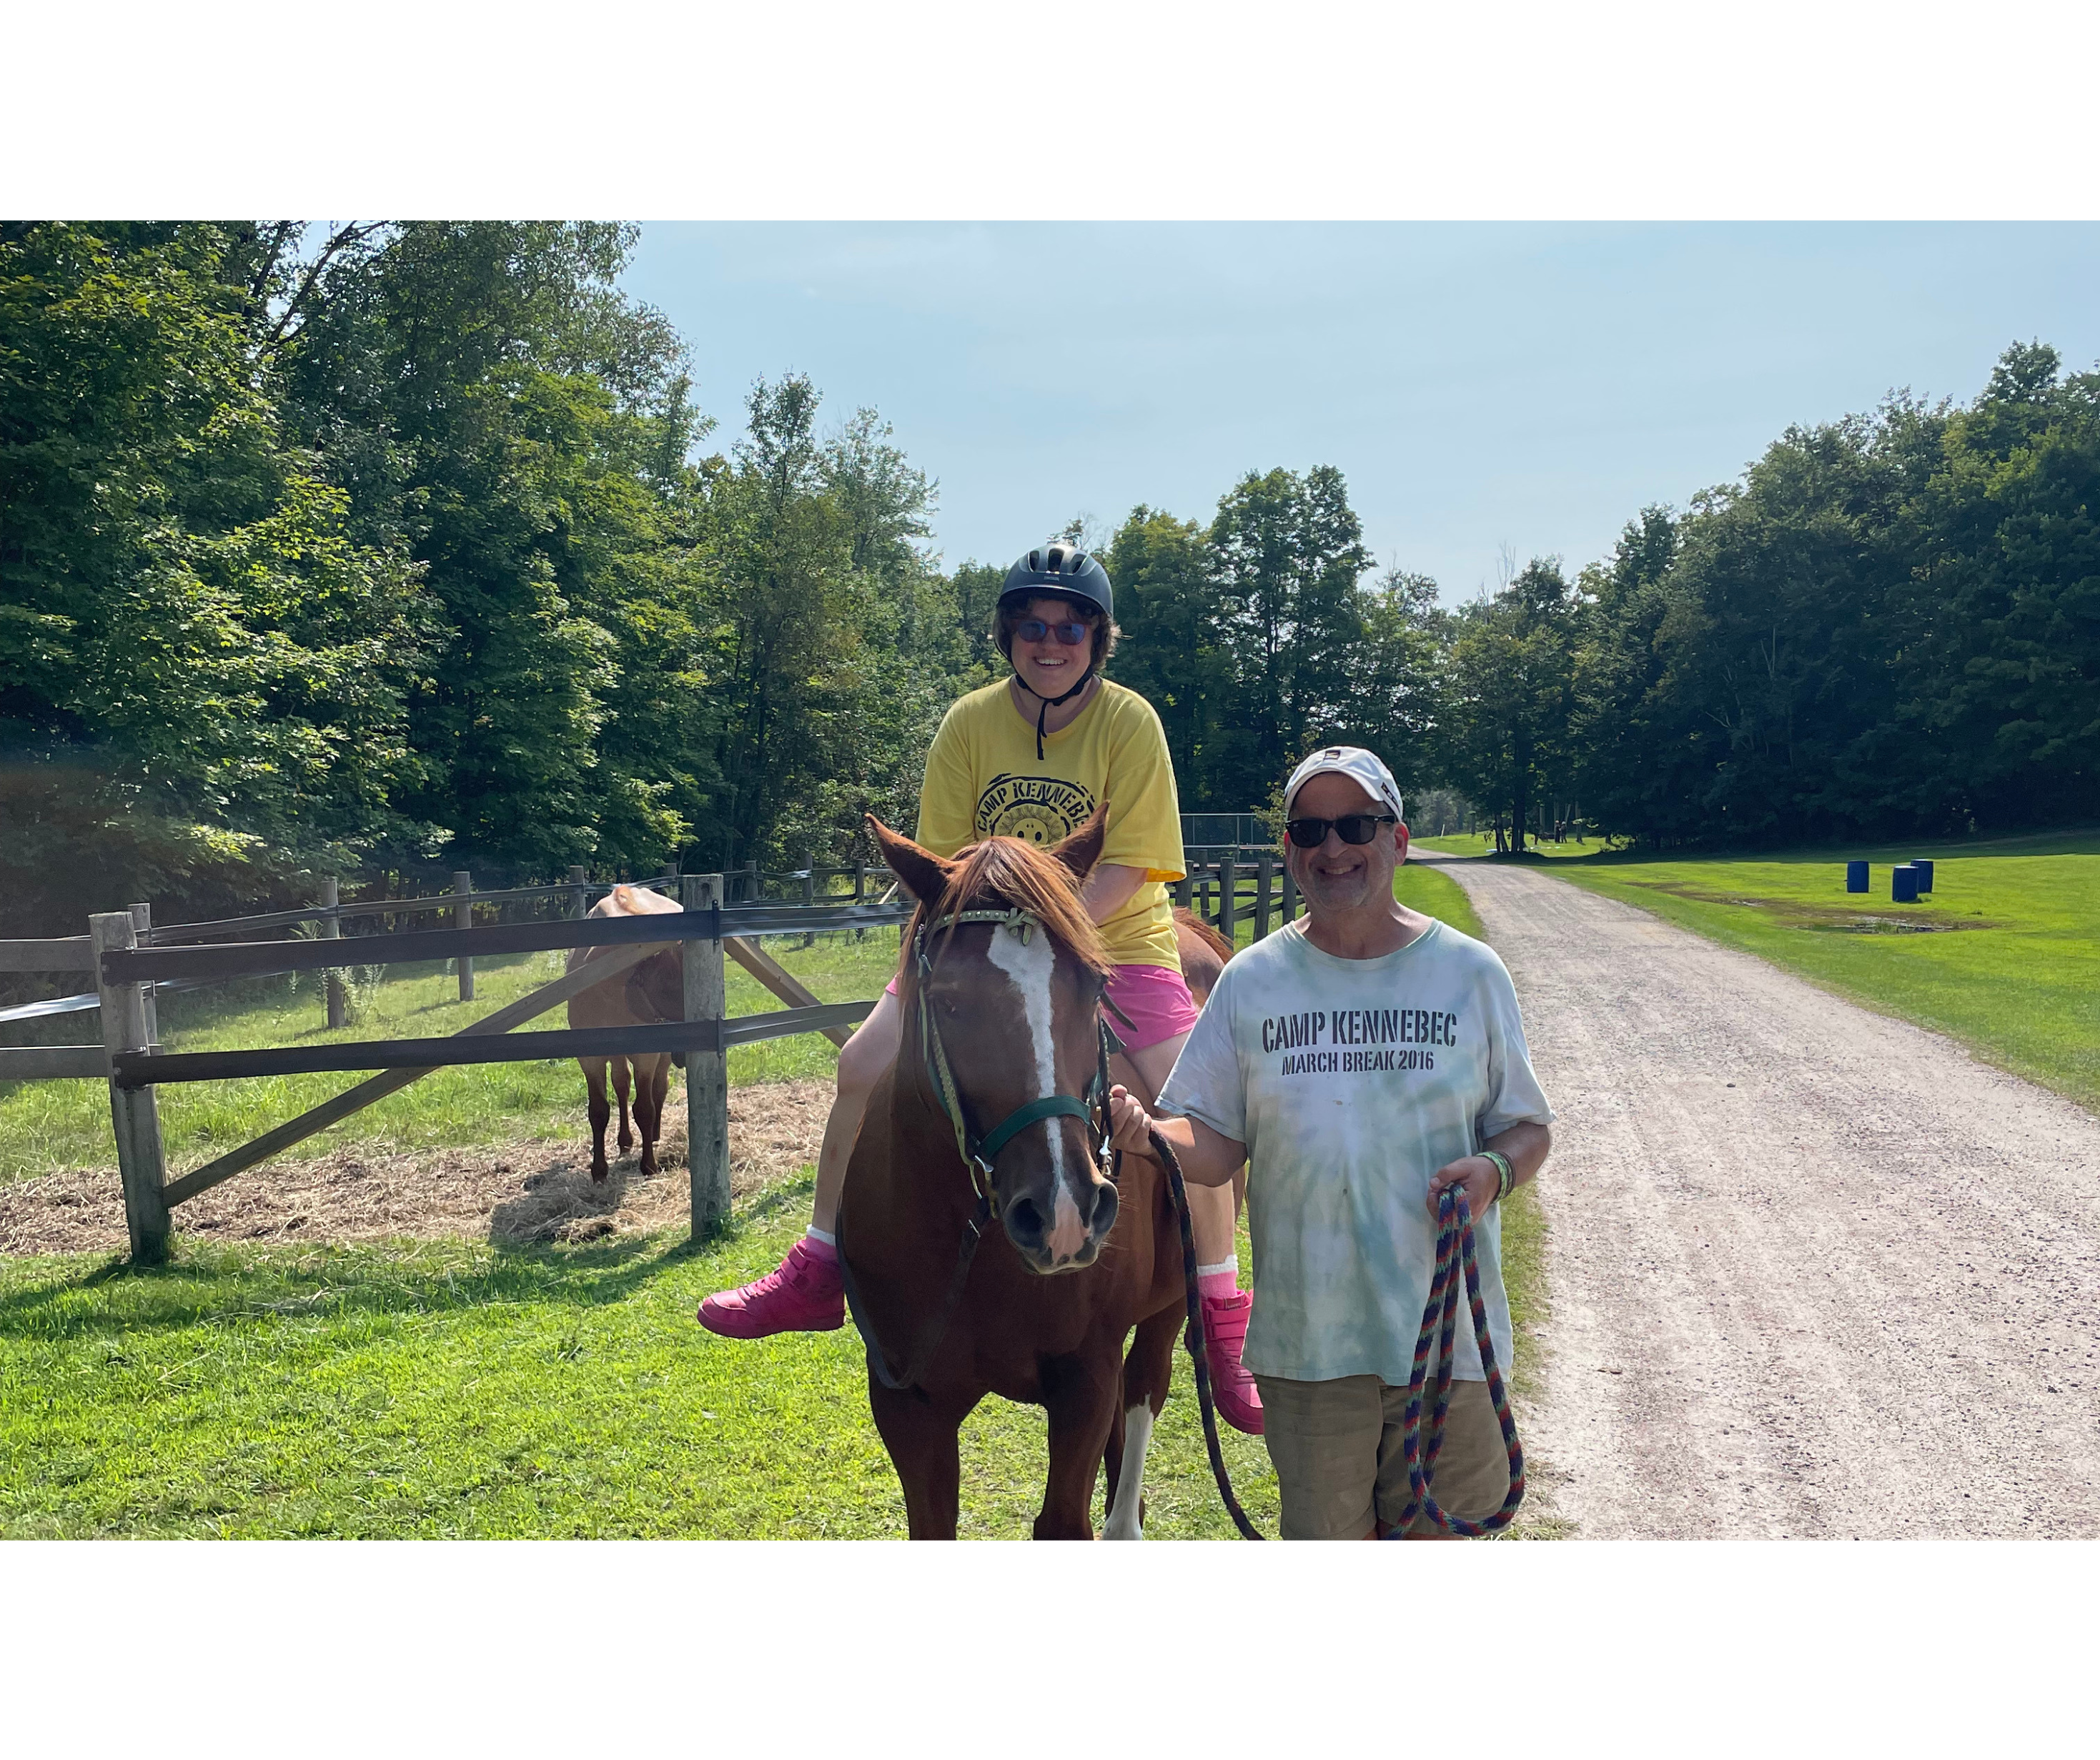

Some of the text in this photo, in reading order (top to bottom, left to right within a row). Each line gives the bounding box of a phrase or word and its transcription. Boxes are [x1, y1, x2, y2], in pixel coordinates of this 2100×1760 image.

[977, 782, 1089, 832] CAMP KENNEBE
[1262, 1009, 1457, 1053] CAMP KENNEBEC
[1282, 1050, 1434, 1075] MARCH BREAK 2016
